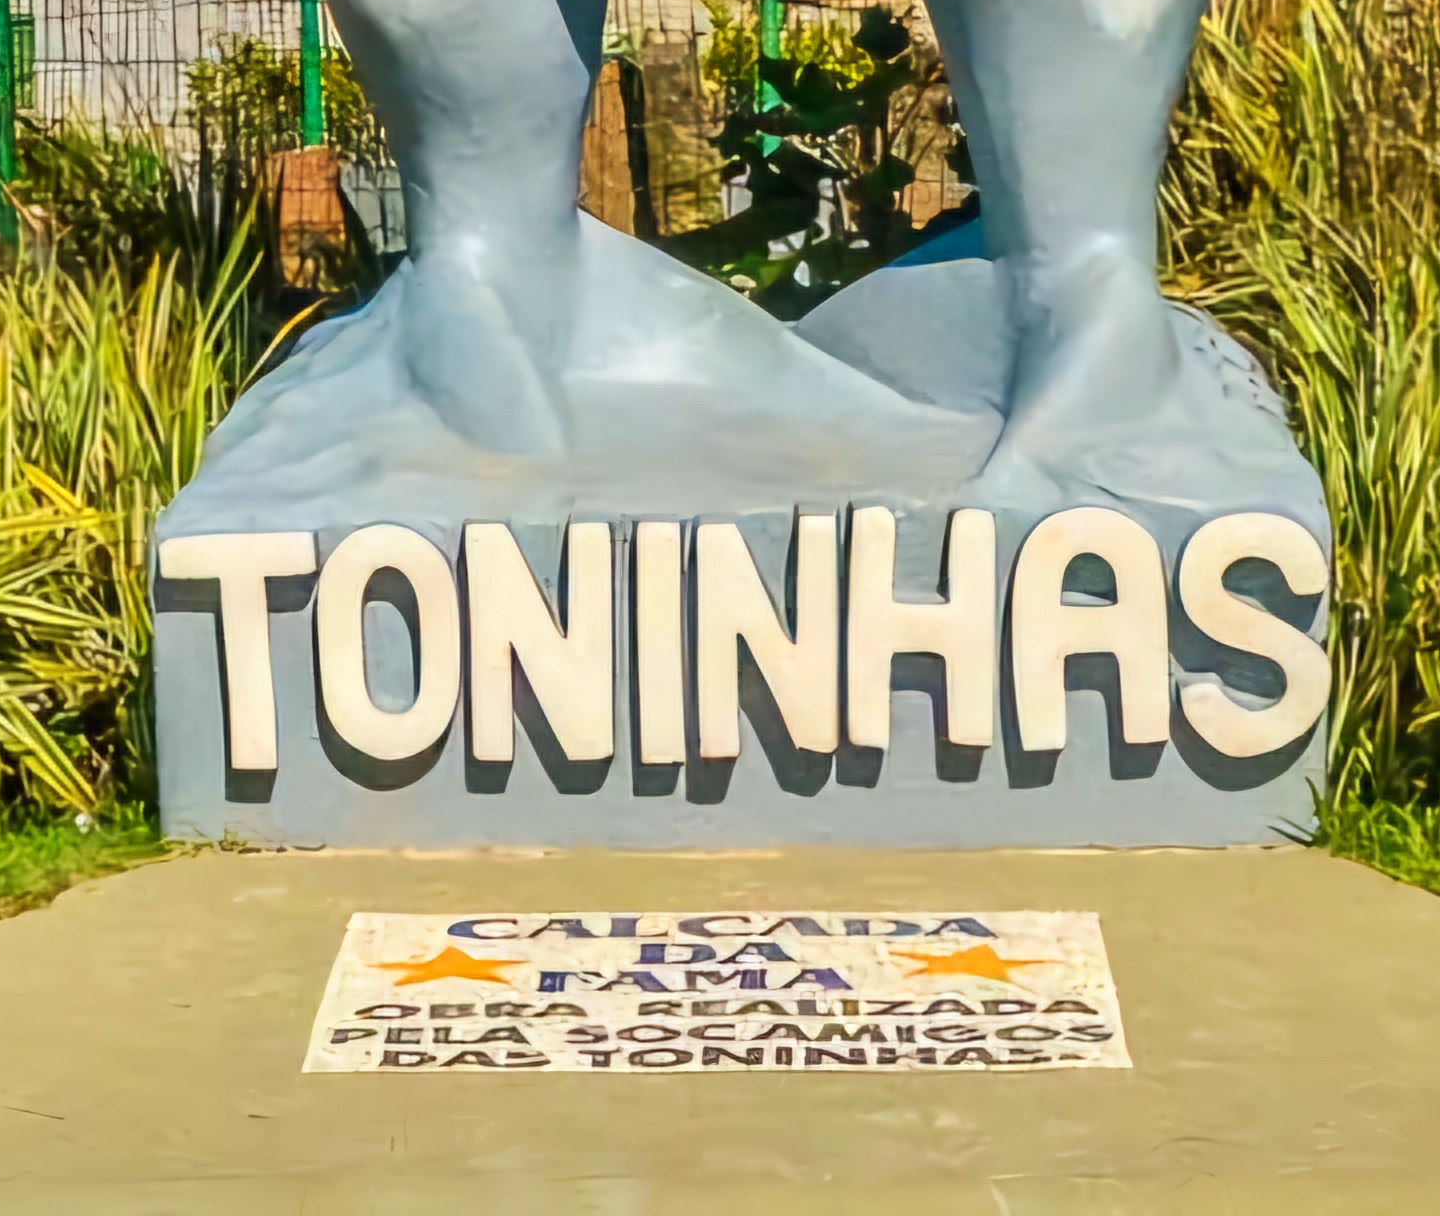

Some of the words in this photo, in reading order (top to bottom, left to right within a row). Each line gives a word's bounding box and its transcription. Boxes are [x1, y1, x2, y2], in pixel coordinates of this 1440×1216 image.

[158, 504, 1332, 772] TONINHAS
[634, 941, 797, 965] DA
[637, 999, 1100, 1018] REALIZADA
[329, 1025, 532, 1045] PELA
[564, 1023, 1114, 1044] SOCAMIGOS
